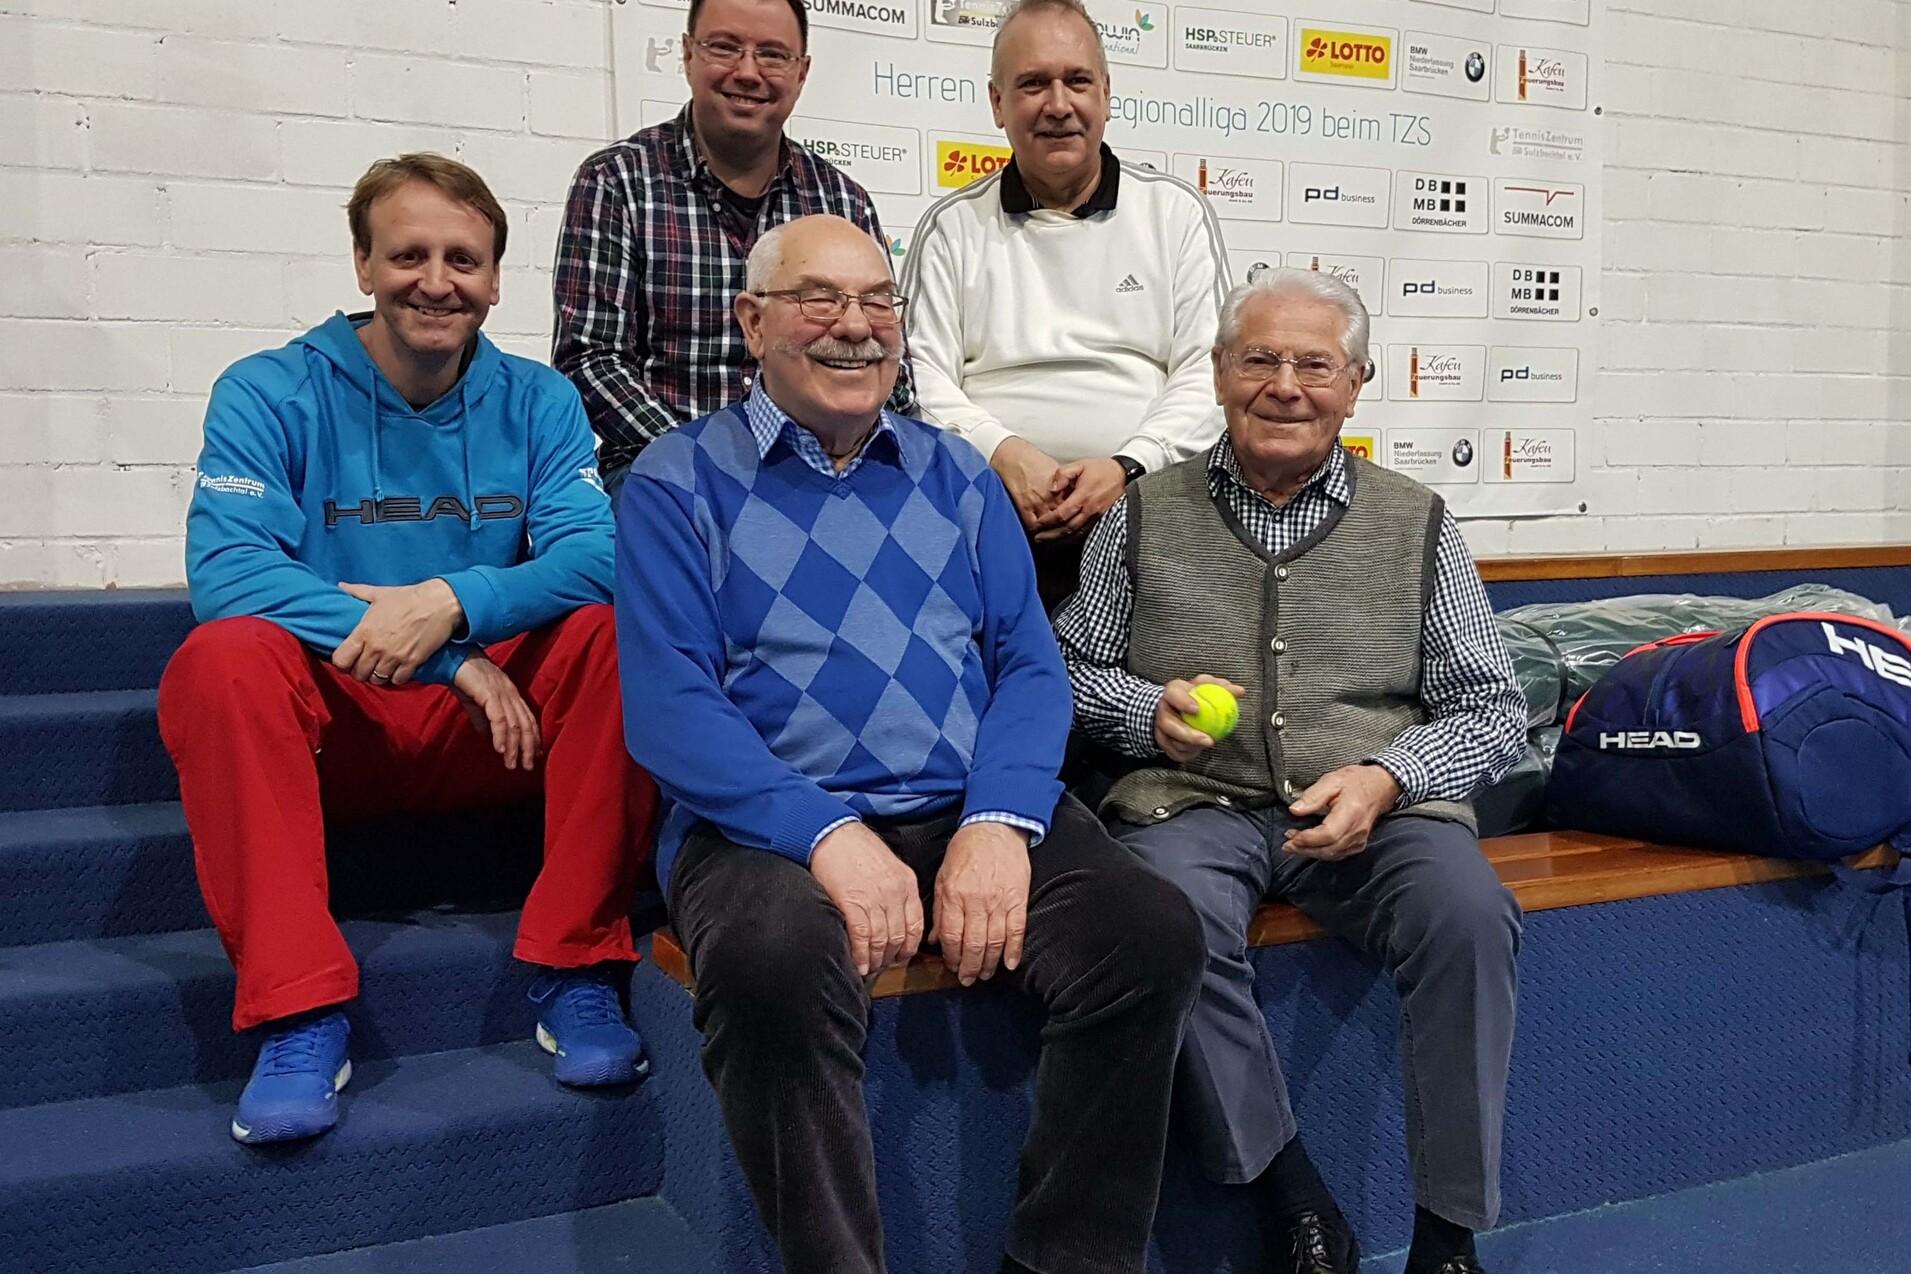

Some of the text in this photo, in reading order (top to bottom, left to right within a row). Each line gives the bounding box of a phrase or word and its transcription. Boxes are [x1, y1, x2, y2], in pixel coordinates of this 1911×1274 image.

[1330, 41, 1386, 64] LOTTO
[1410, 45, 1428, 55] BMW
[874, 61, 1432, 146] Herren egionalliga 2019 beim TZS
[971, 154, 1010, 174] LOT
[1305, 186, 1375, 204] pd business
[1504, 211, 1573, 229] SUMMACOM
[1403, 280, 1473, 297] pd business
[1500, 366, 1563, 383] pd business
[1393, 441, 1414, 449] BMW
[1393, 450, 1443, 459] Niederlassung
[324, 495, 523, 526] HEAD
[1821, 622, 1911, 687] HE
[1600, 732, 1701, 749] HEAD
